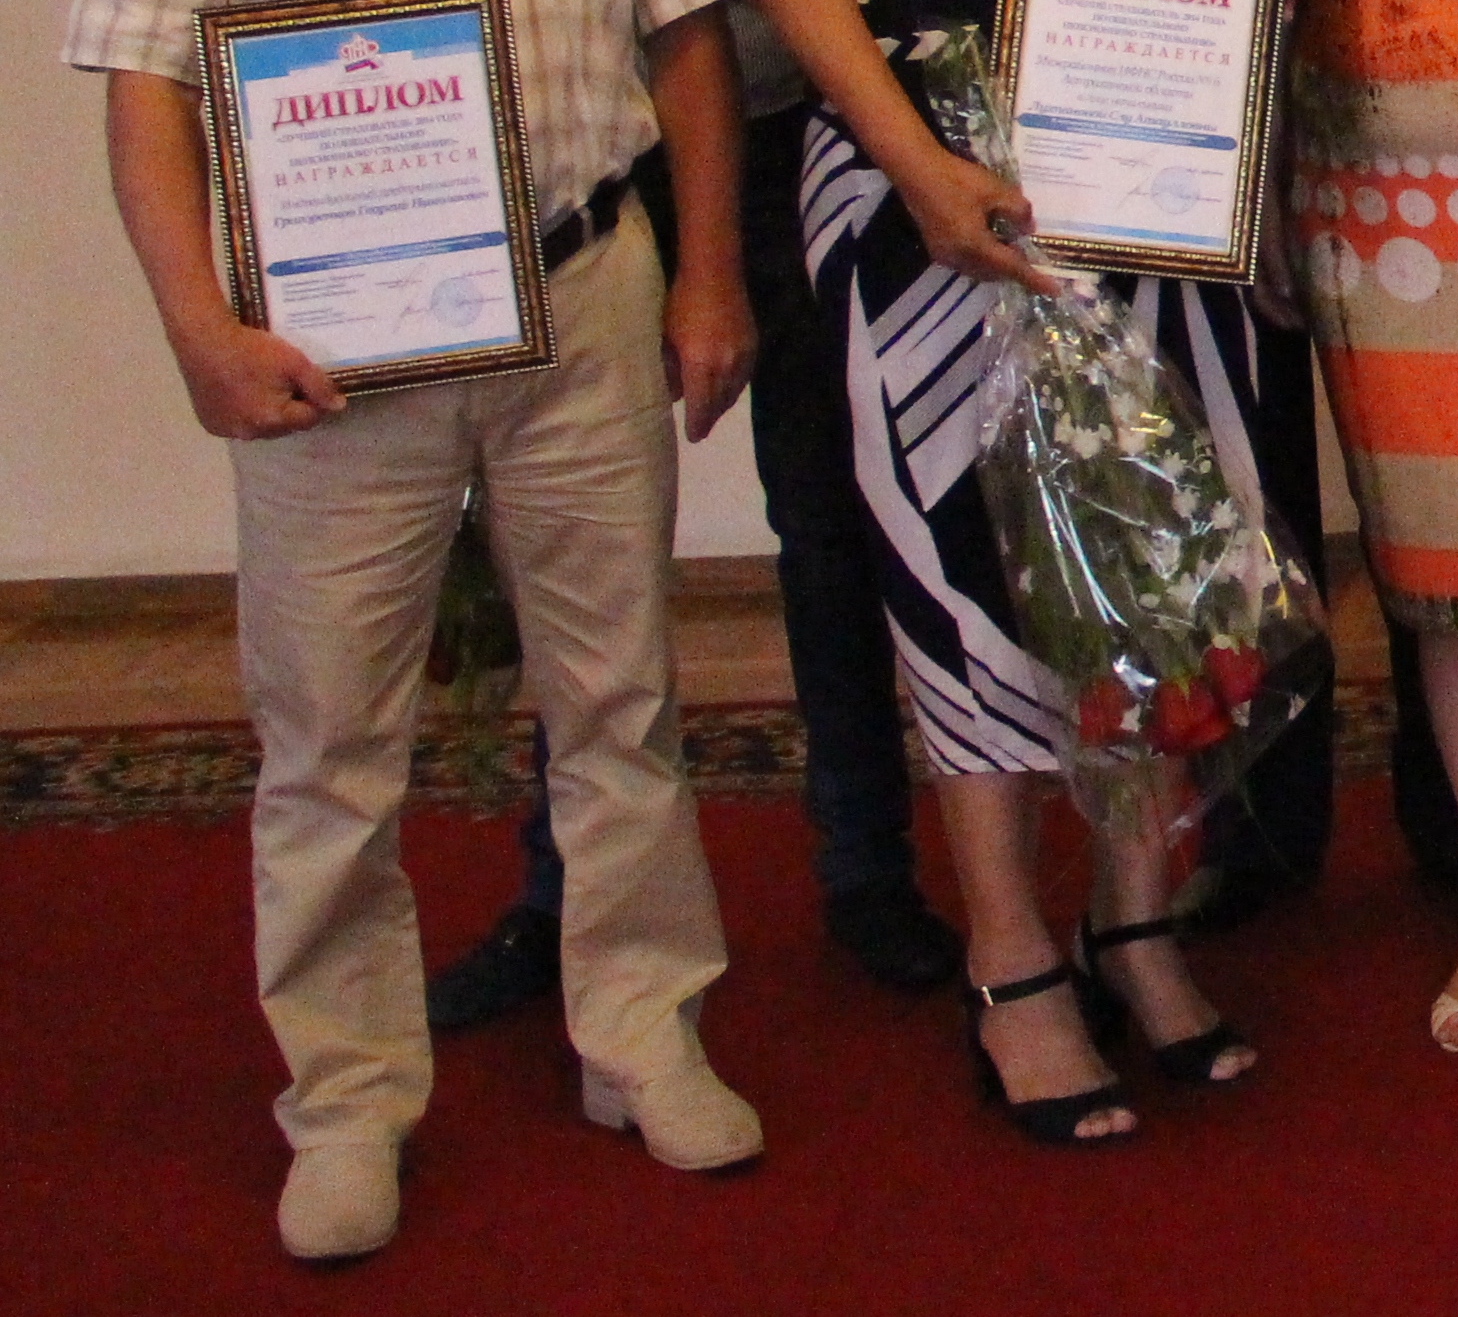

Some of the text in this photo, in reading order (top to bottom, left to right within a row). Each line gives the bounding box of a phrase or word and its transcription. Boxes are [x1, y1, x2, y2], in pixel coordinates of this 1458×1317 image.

[1046, 31, 1230, 65] НАГРАЖДАЕТСЯ
[270, 75, 463, 130] ДИПЛОМ
[275, 147, 478, 186] НАГРАЖДАЕТСЯ
